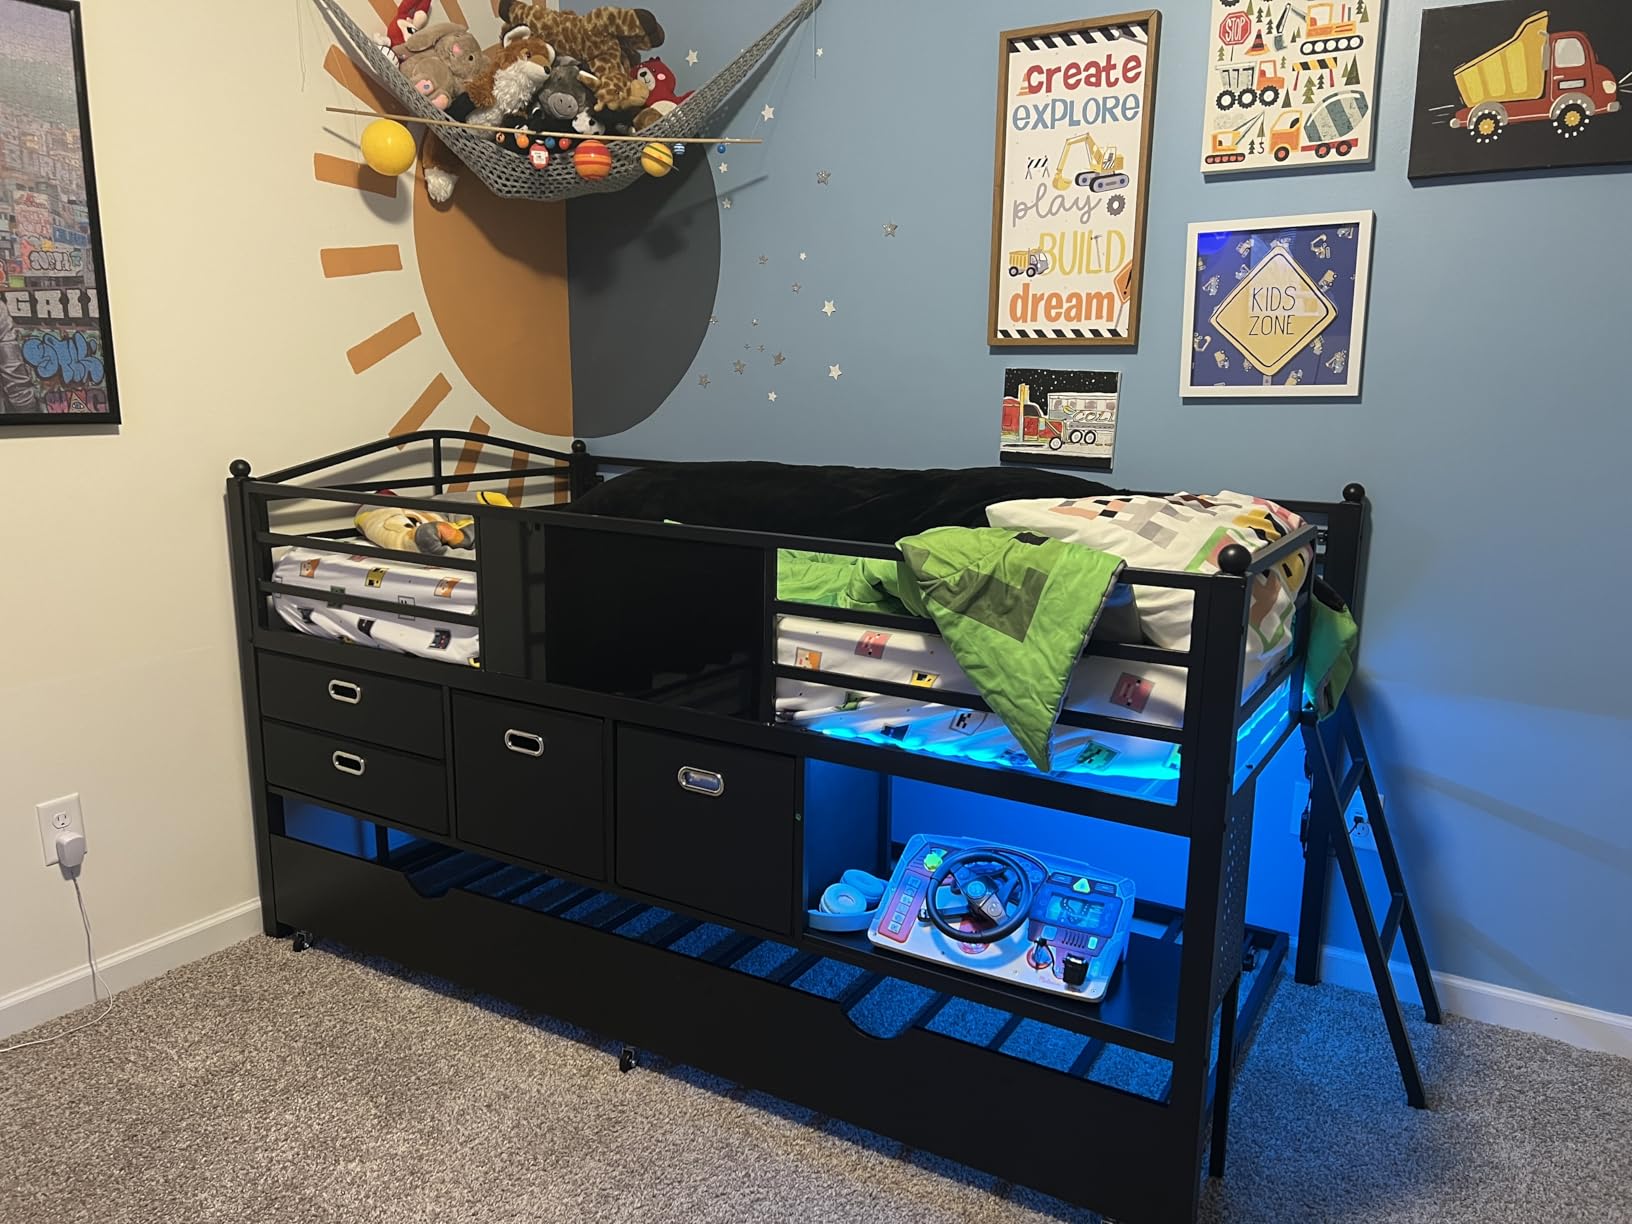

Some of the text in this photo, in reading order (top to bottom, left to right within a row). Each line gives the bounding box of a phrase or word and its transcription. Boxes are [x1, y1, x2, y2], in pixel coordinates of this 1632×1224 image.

[1225, 16, 1246, 42] STOP
[1026, 54, 1142, 94] create
[1012, 182, 1102, 228] play
[1039, 229, 1126, 277] BUILD
[1009, 282, 1115, 324] dream
[1251, 285, 1297, 313] KIDS
[1248, 314, 1296, 336] ZONE
